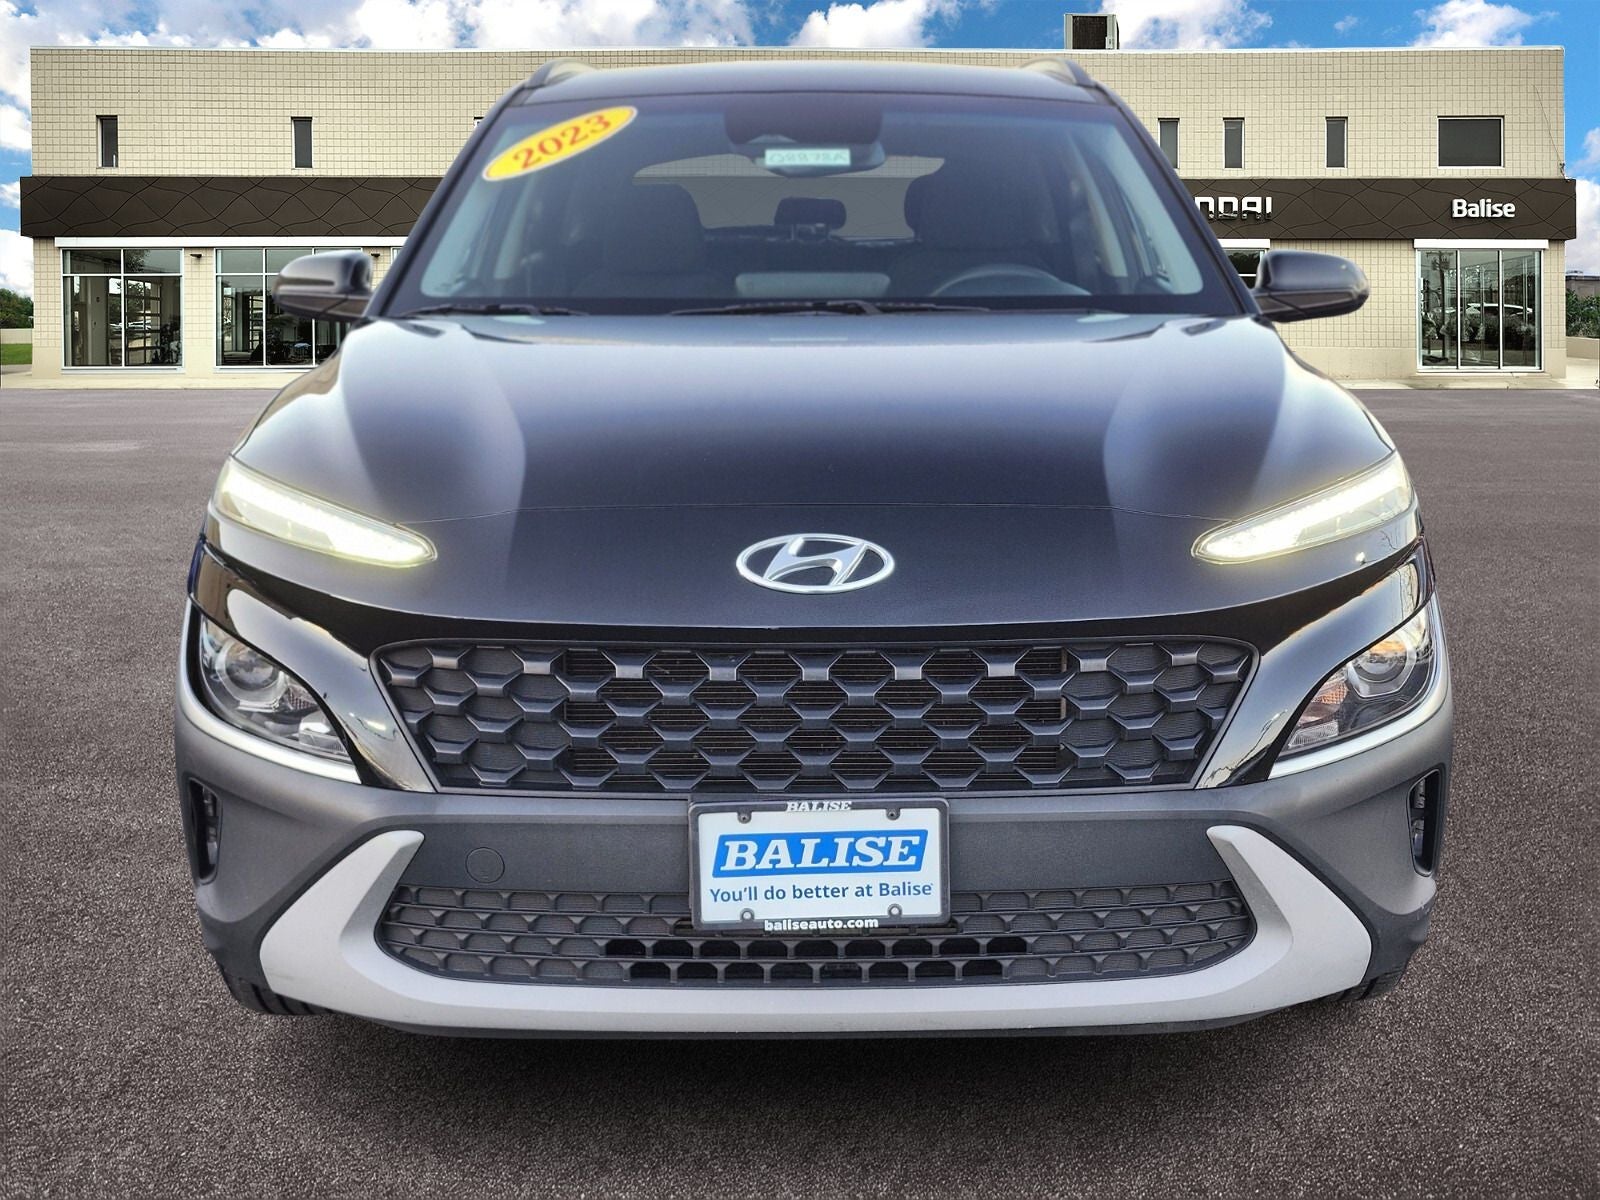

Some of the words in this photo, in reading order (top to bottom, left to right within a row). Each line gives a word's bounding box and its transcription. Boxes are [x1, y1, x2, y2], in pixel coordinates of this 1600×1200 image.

[512, 114, 611, 170] 2023
[1452, 198, 1516, 218] Balise
[786, 800, 852, 812] BALISE
[719, 834, 921, 872] BALISE
[710, 886, 758, 903] You'll
[763, 886, 786, 901] do
[792, 882, 849, 900] better
[854, 883, 873, 898] at
[879, 880, 932, 897] Balise
[764, 918, 879, 932] baliseauto.com
